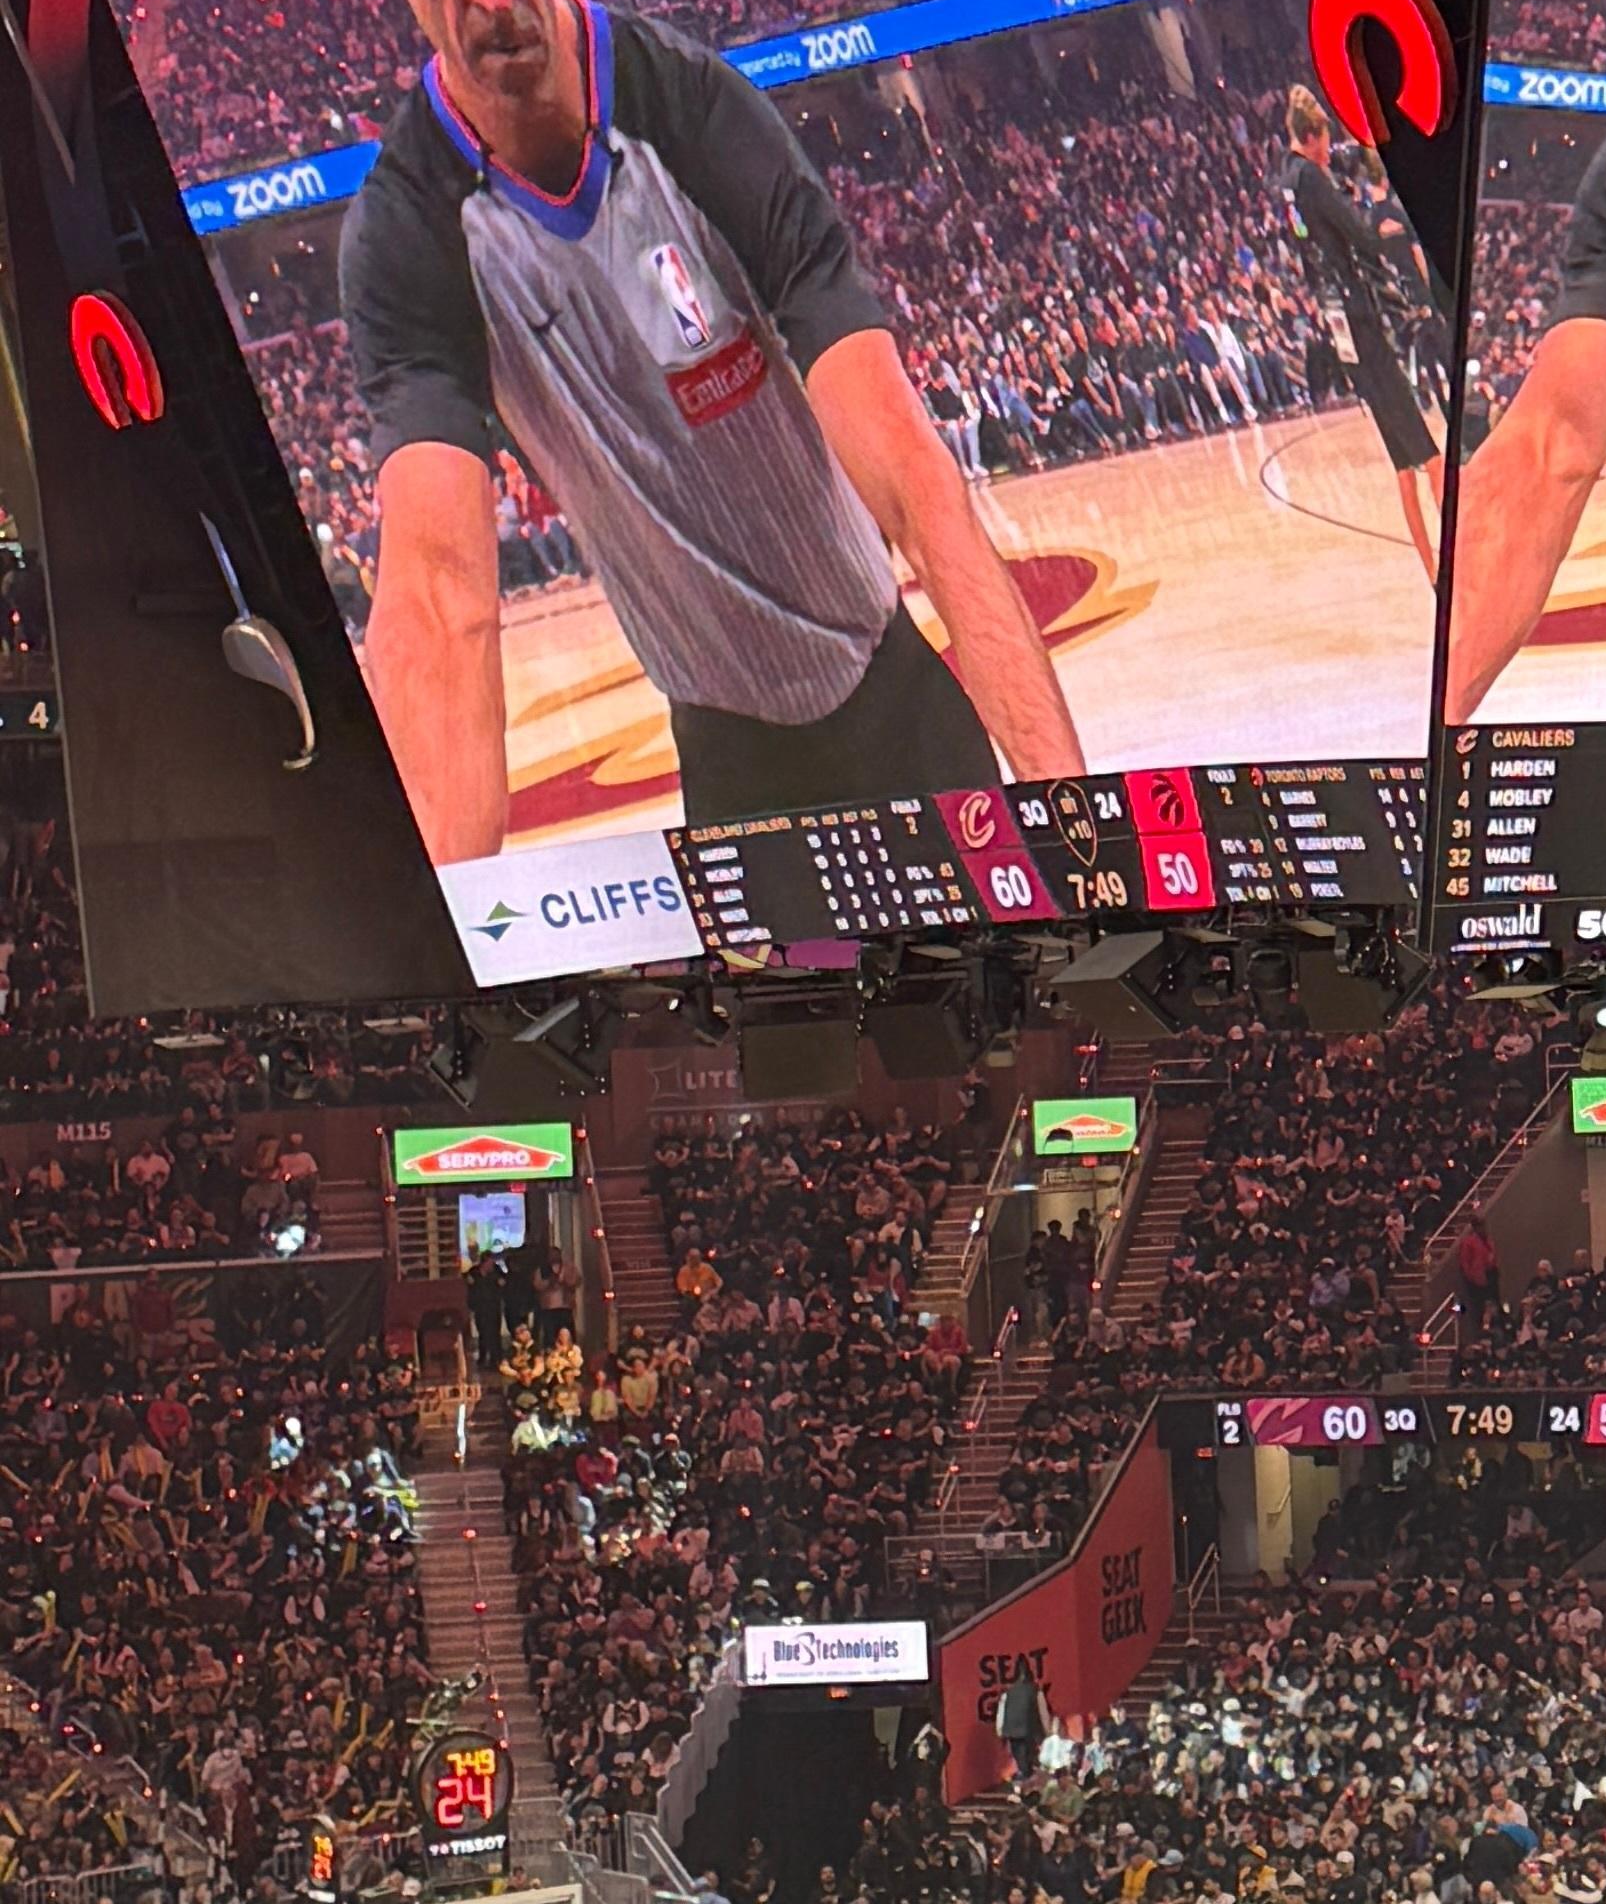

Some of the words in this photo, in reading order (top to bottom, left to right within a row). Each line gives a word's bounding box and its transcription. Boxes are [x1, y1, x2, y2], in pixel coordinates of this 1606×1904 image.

[801, 23, 878, 70] zoom
[227, 163, 326, 220] zoom
[1492, 728, 1575, 747] CAVALIERS
[1490, 758, 1556, 778] HARDEN
[1093, 791, 1124, 820] 24
[1488, 788, 1553, 807] MOBLEY
[1451, 819, 1472, 839] 31
[1486, 817, 1537, 836] ALLEN
[1448, 849, 1472, 868] 32
[1485, 846, 1532, 865] WADE
[989, 864, 1032, 908] 60
[1157, 851, 1200, 896] 50
[1446, 877, 1470, 897] 45
[1483, 874, 1558, 894] MITCHELL
[539, 874, 682, 930] CLIFFS
[1066, 870, 1129, 910] 7:49
[1460, 902, 1543, 940] oswald
[685, 1070, 739, 1091] LITE
[437, 1150, 531, 1169] SERVPRO
[1222, 1420, 1240, 1444] 2
[1322, 1405, 1368, 1441] 60
[1383, 1408, 1417, 1432] 3Q
[1446, 1403, 1514, 1435] 7:49
[1549, 1405, 1581, 1432] 24
[814, 1637, 900, 1666] Technologies
[978, 1646, 1050, 1689] SEAT
[437, 1775, 494, 1826] 24
[450, 1834, 507, 1856] TISSOT
